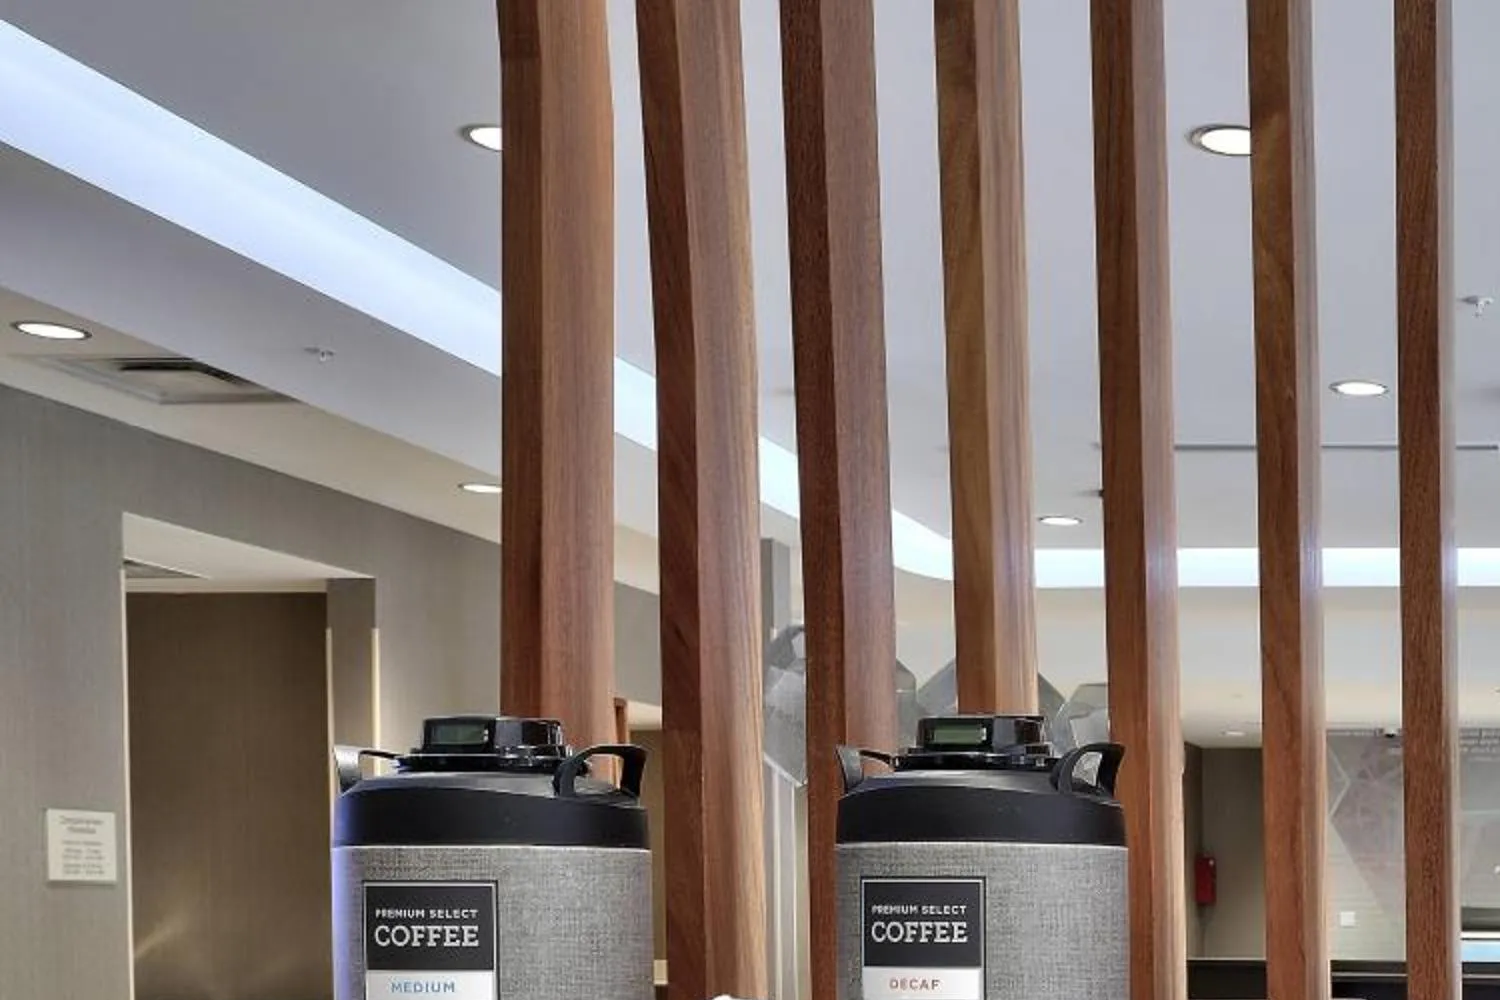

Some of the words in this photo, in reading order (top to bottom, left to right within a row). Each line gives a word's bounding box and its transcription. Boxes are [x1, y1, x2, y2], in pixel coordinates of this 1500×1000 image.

[375, 909, 425, 919] PREMIUM
[429, 909, 479, 919] SELECT
[871, 905, 918, 916] PREMIUM
[921, 905, 967, 915] SELECT
[374, 925, 479, 947] COFFEE
[871, 922, 968, 943] COFFEE
[391, 982, 455, 993] MEDIUM
[889, 979, 940, 990] DECAF
